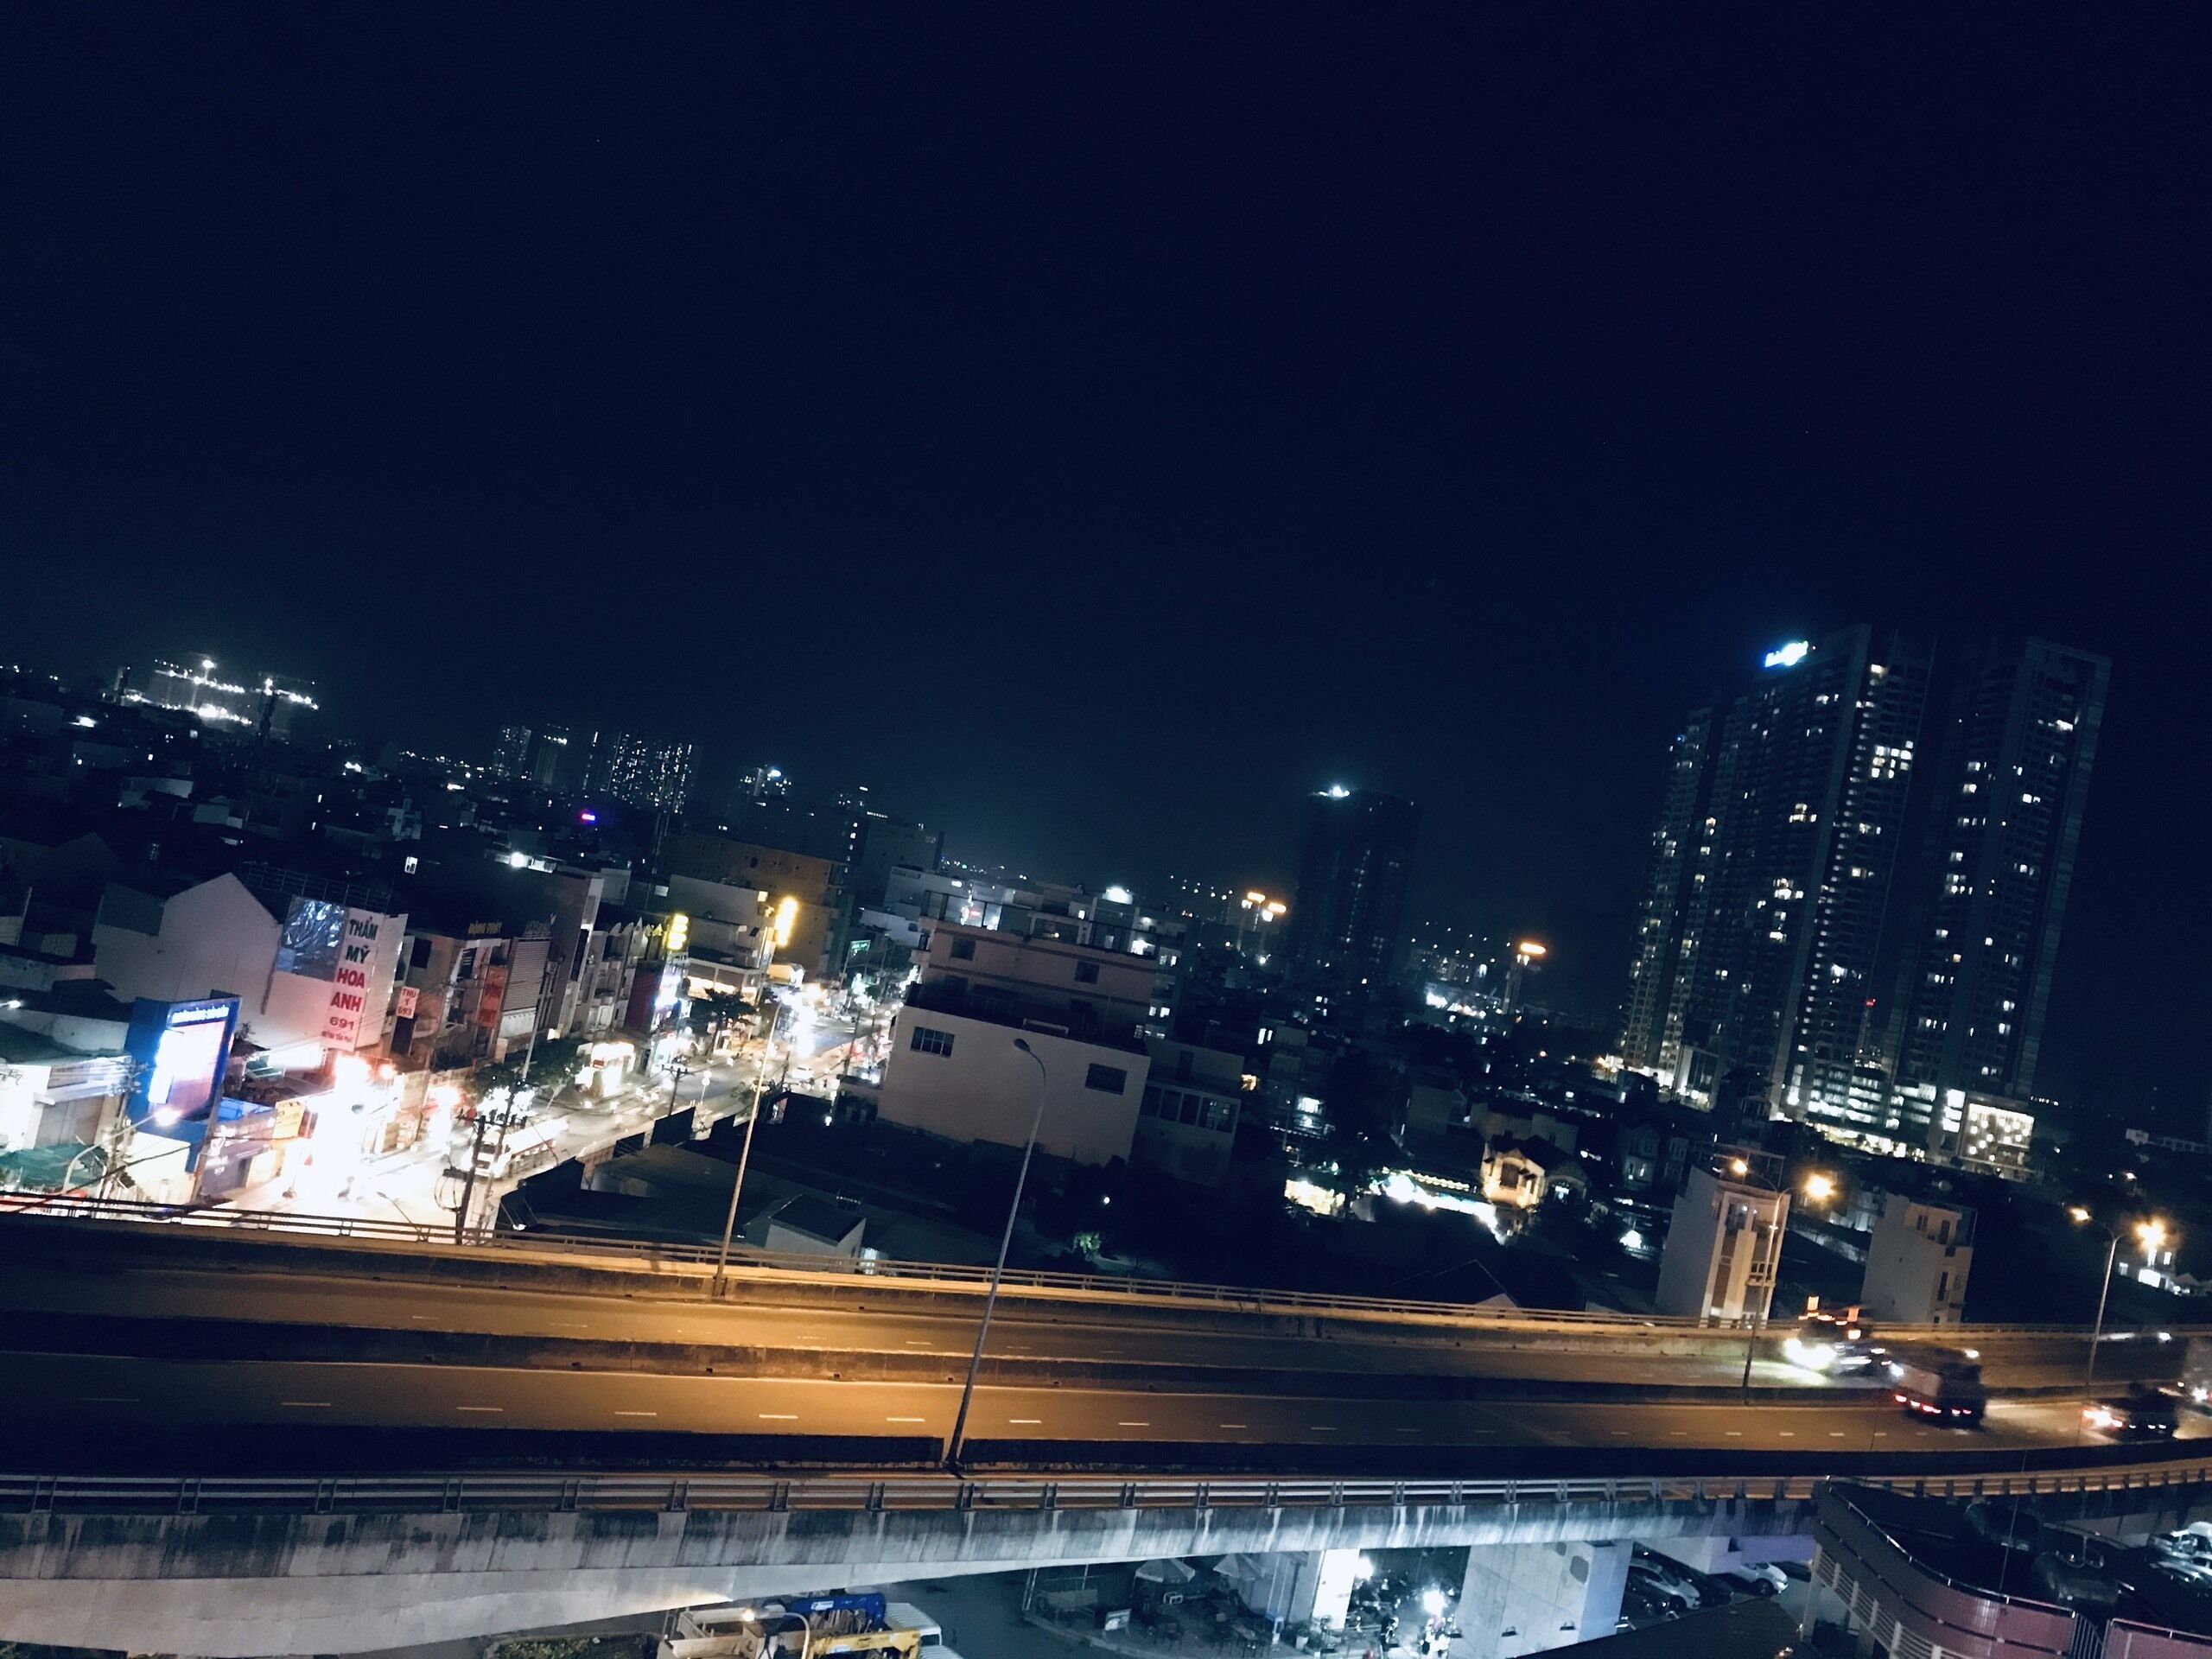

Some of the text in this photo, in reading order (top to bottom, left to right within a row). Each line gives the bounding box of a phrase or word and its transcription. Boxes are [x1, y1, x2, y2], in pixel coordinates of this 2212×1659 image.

[346, 944, 371, 963] MỸ
[337, 968, 365, 988] HOA
[330, 992, 362, 1012] ANH
[330, 1017, 354, 1030] 691
